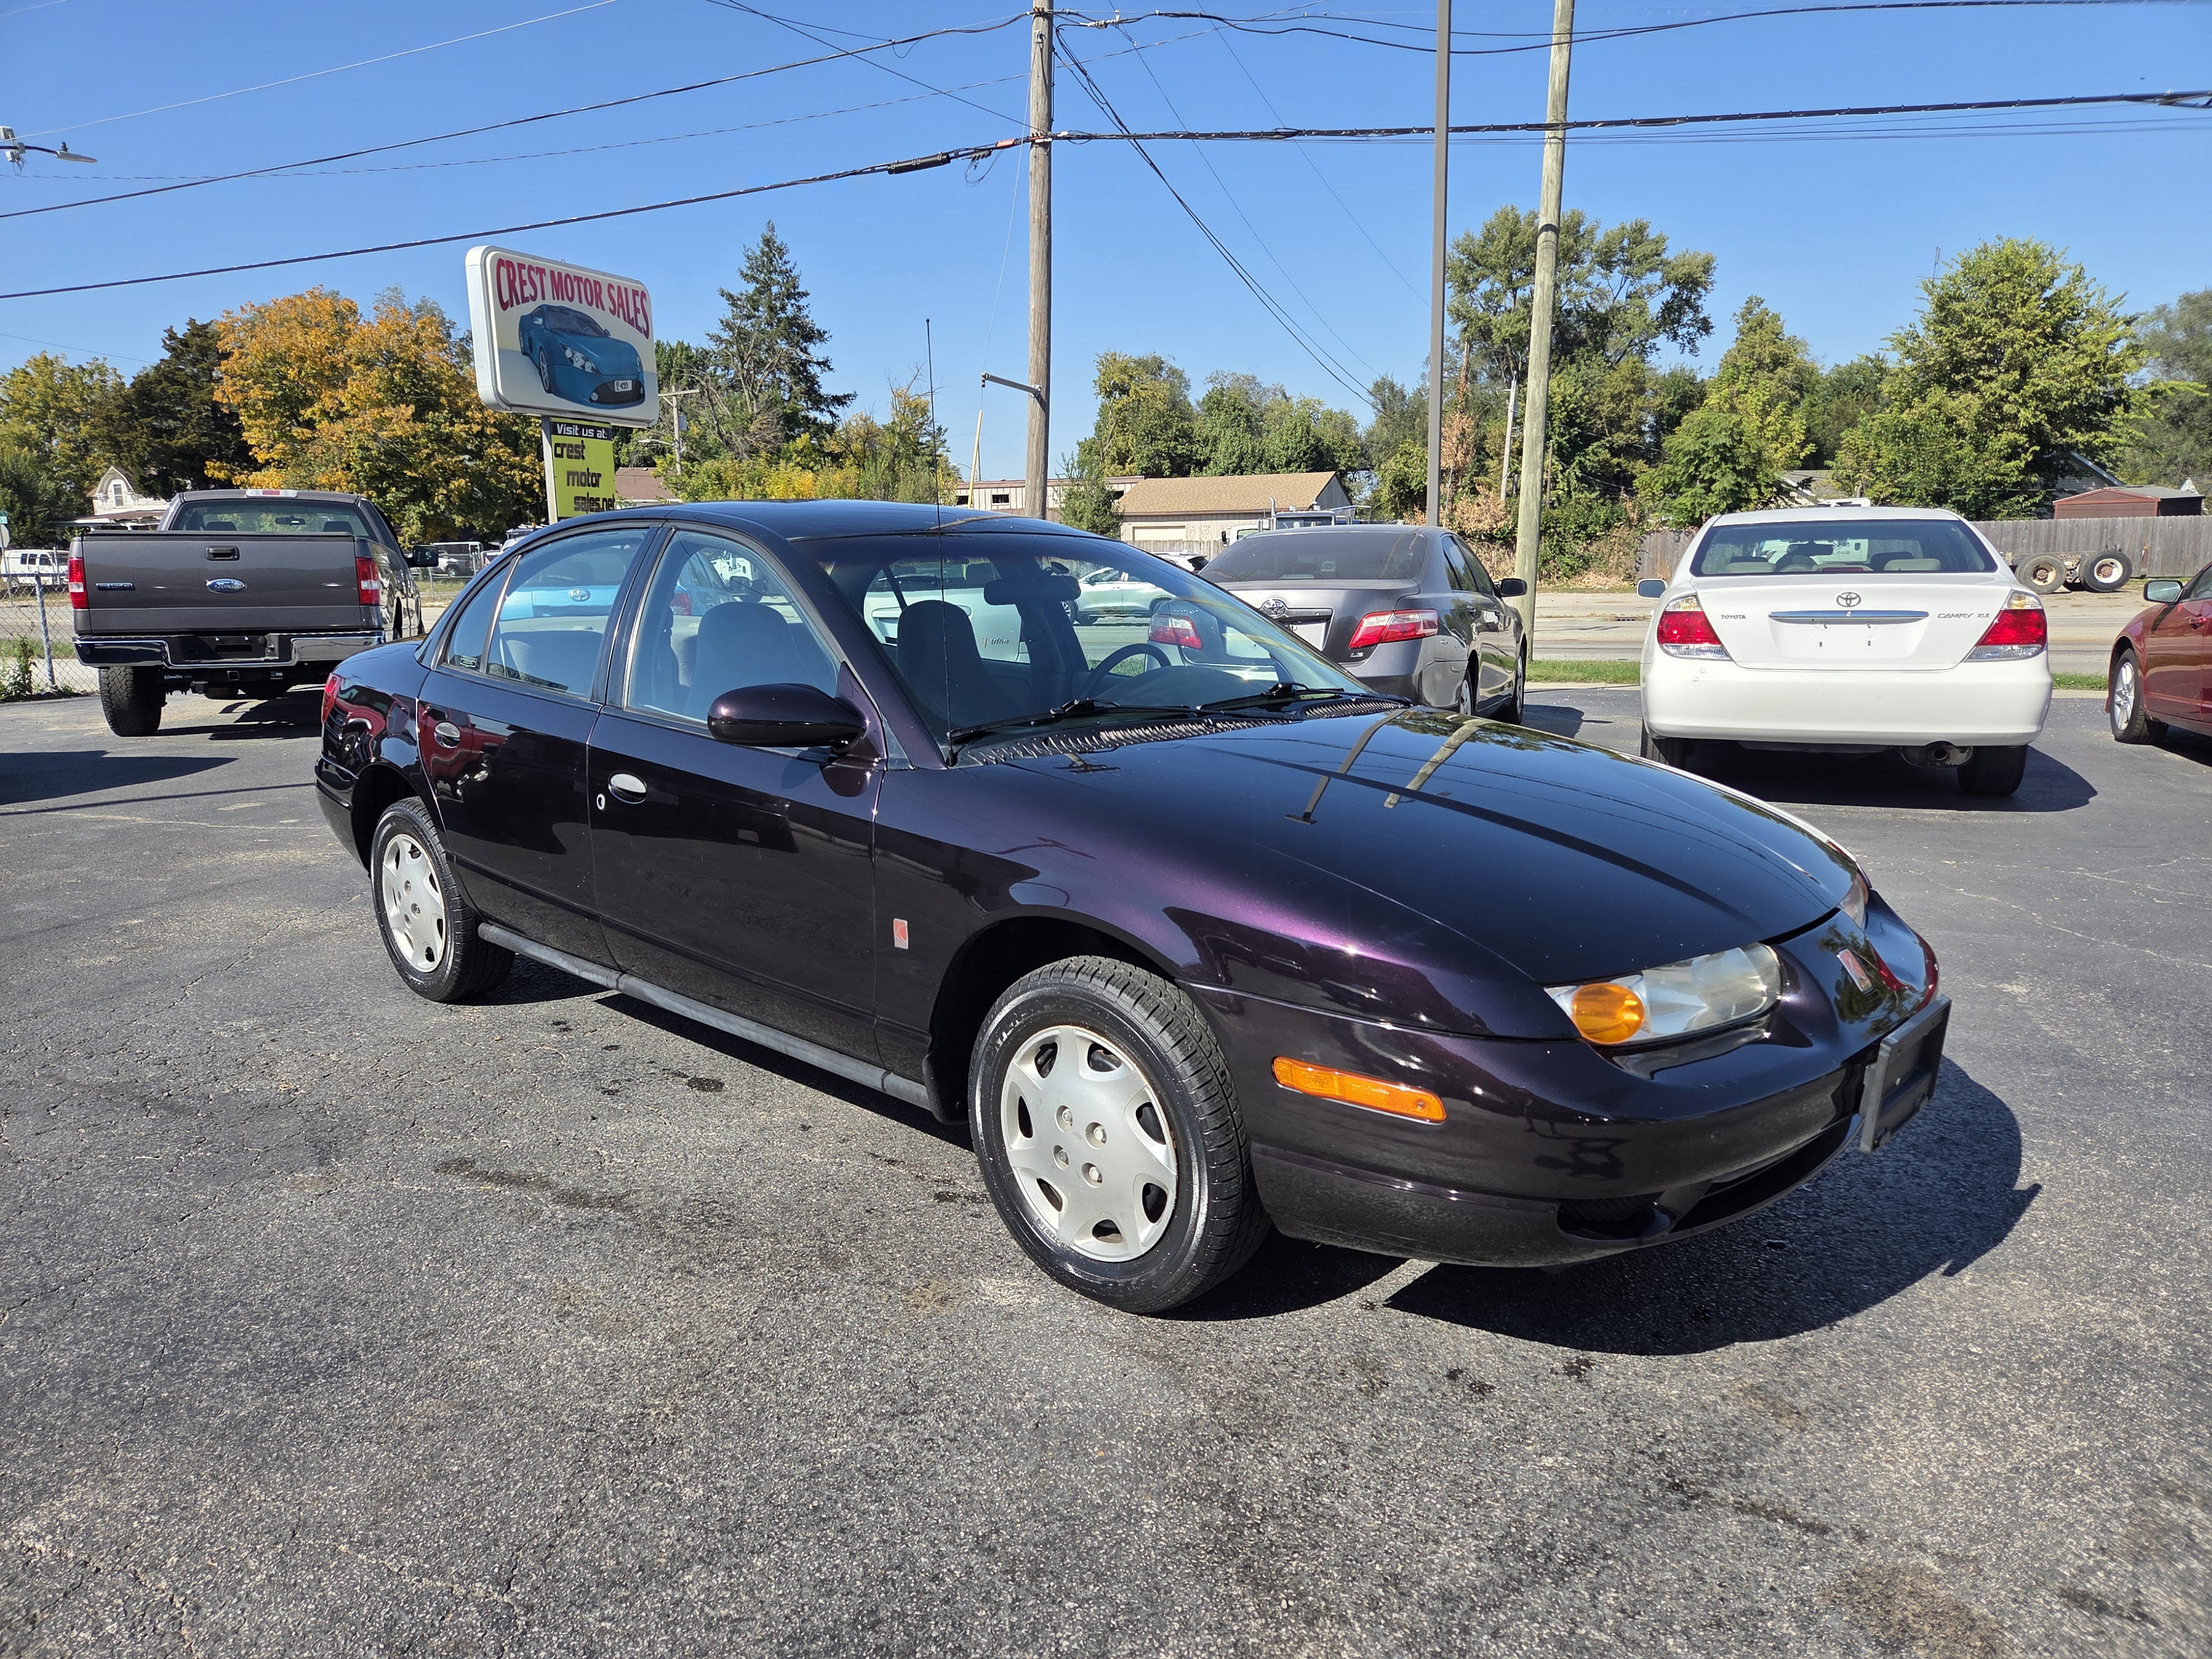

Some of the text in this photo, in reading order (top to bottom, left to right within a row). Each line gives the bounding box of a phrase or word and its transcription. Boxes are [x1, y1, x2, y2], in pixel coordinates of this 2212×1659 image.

[497, 258, 650, 340] CREST MOTOR SALES
[557, 423, 608, 439] Visit us at:
[554, 440, 586, 461] crest
[567, 467, 602, 488] motor
[573, 492, 615, 515] sales.net
